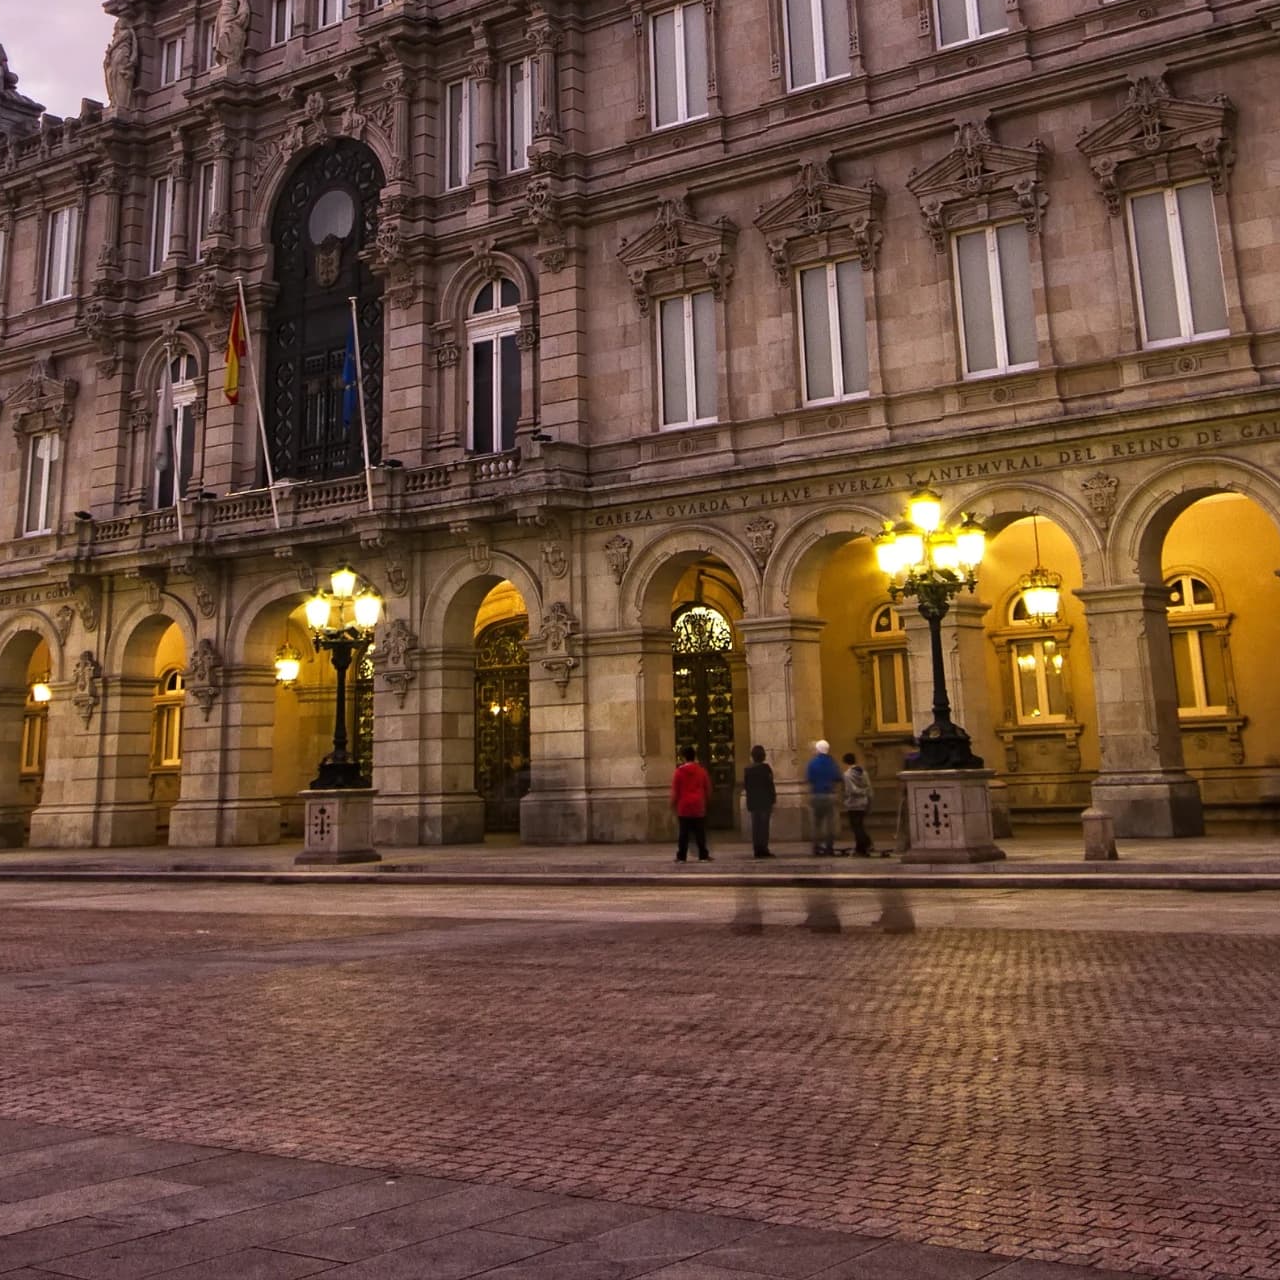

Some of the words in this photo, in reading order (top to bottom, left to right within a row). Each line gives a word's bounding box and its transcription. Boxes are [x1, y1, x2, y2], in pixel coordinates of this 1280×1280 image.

[595, 509, 653, 527] CABEZA
[666, 499, 730, 518] GVARDA
[740, 495, 750, 508] Y
[760, 486, 812, 505] LLAVE
[827, 475, 895, 496] FVERZA
[904, 471, 918, 485] Y
[928, 455, 1043, 482] ANTEMVRAL
[1059, 447, 1097, 464] DEL
[1112, 435, 1180, 457] REINO
[1197, 431, 1223, 446] DE
